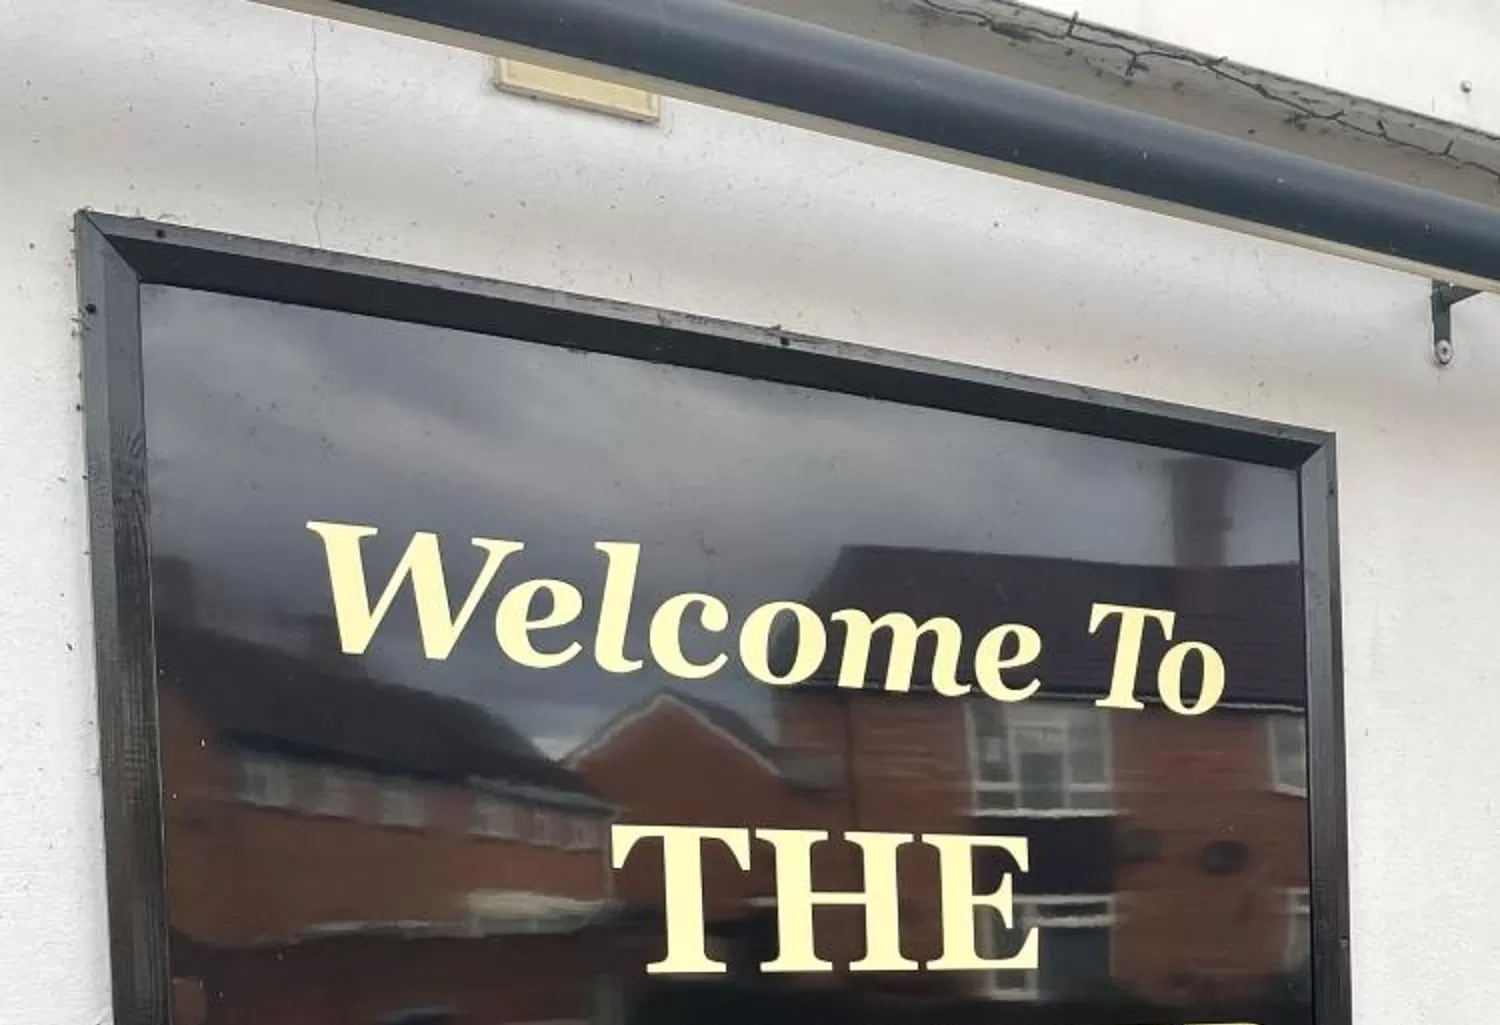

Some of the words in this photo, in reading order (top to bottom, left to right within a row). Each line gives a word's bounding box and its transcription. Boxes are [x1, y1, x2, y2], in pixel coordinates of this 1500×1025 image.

[307, 520, 1042, 703] Welcome
[1087, 602, 1226, 716] To
[610, 825, 1041, 976] THE
